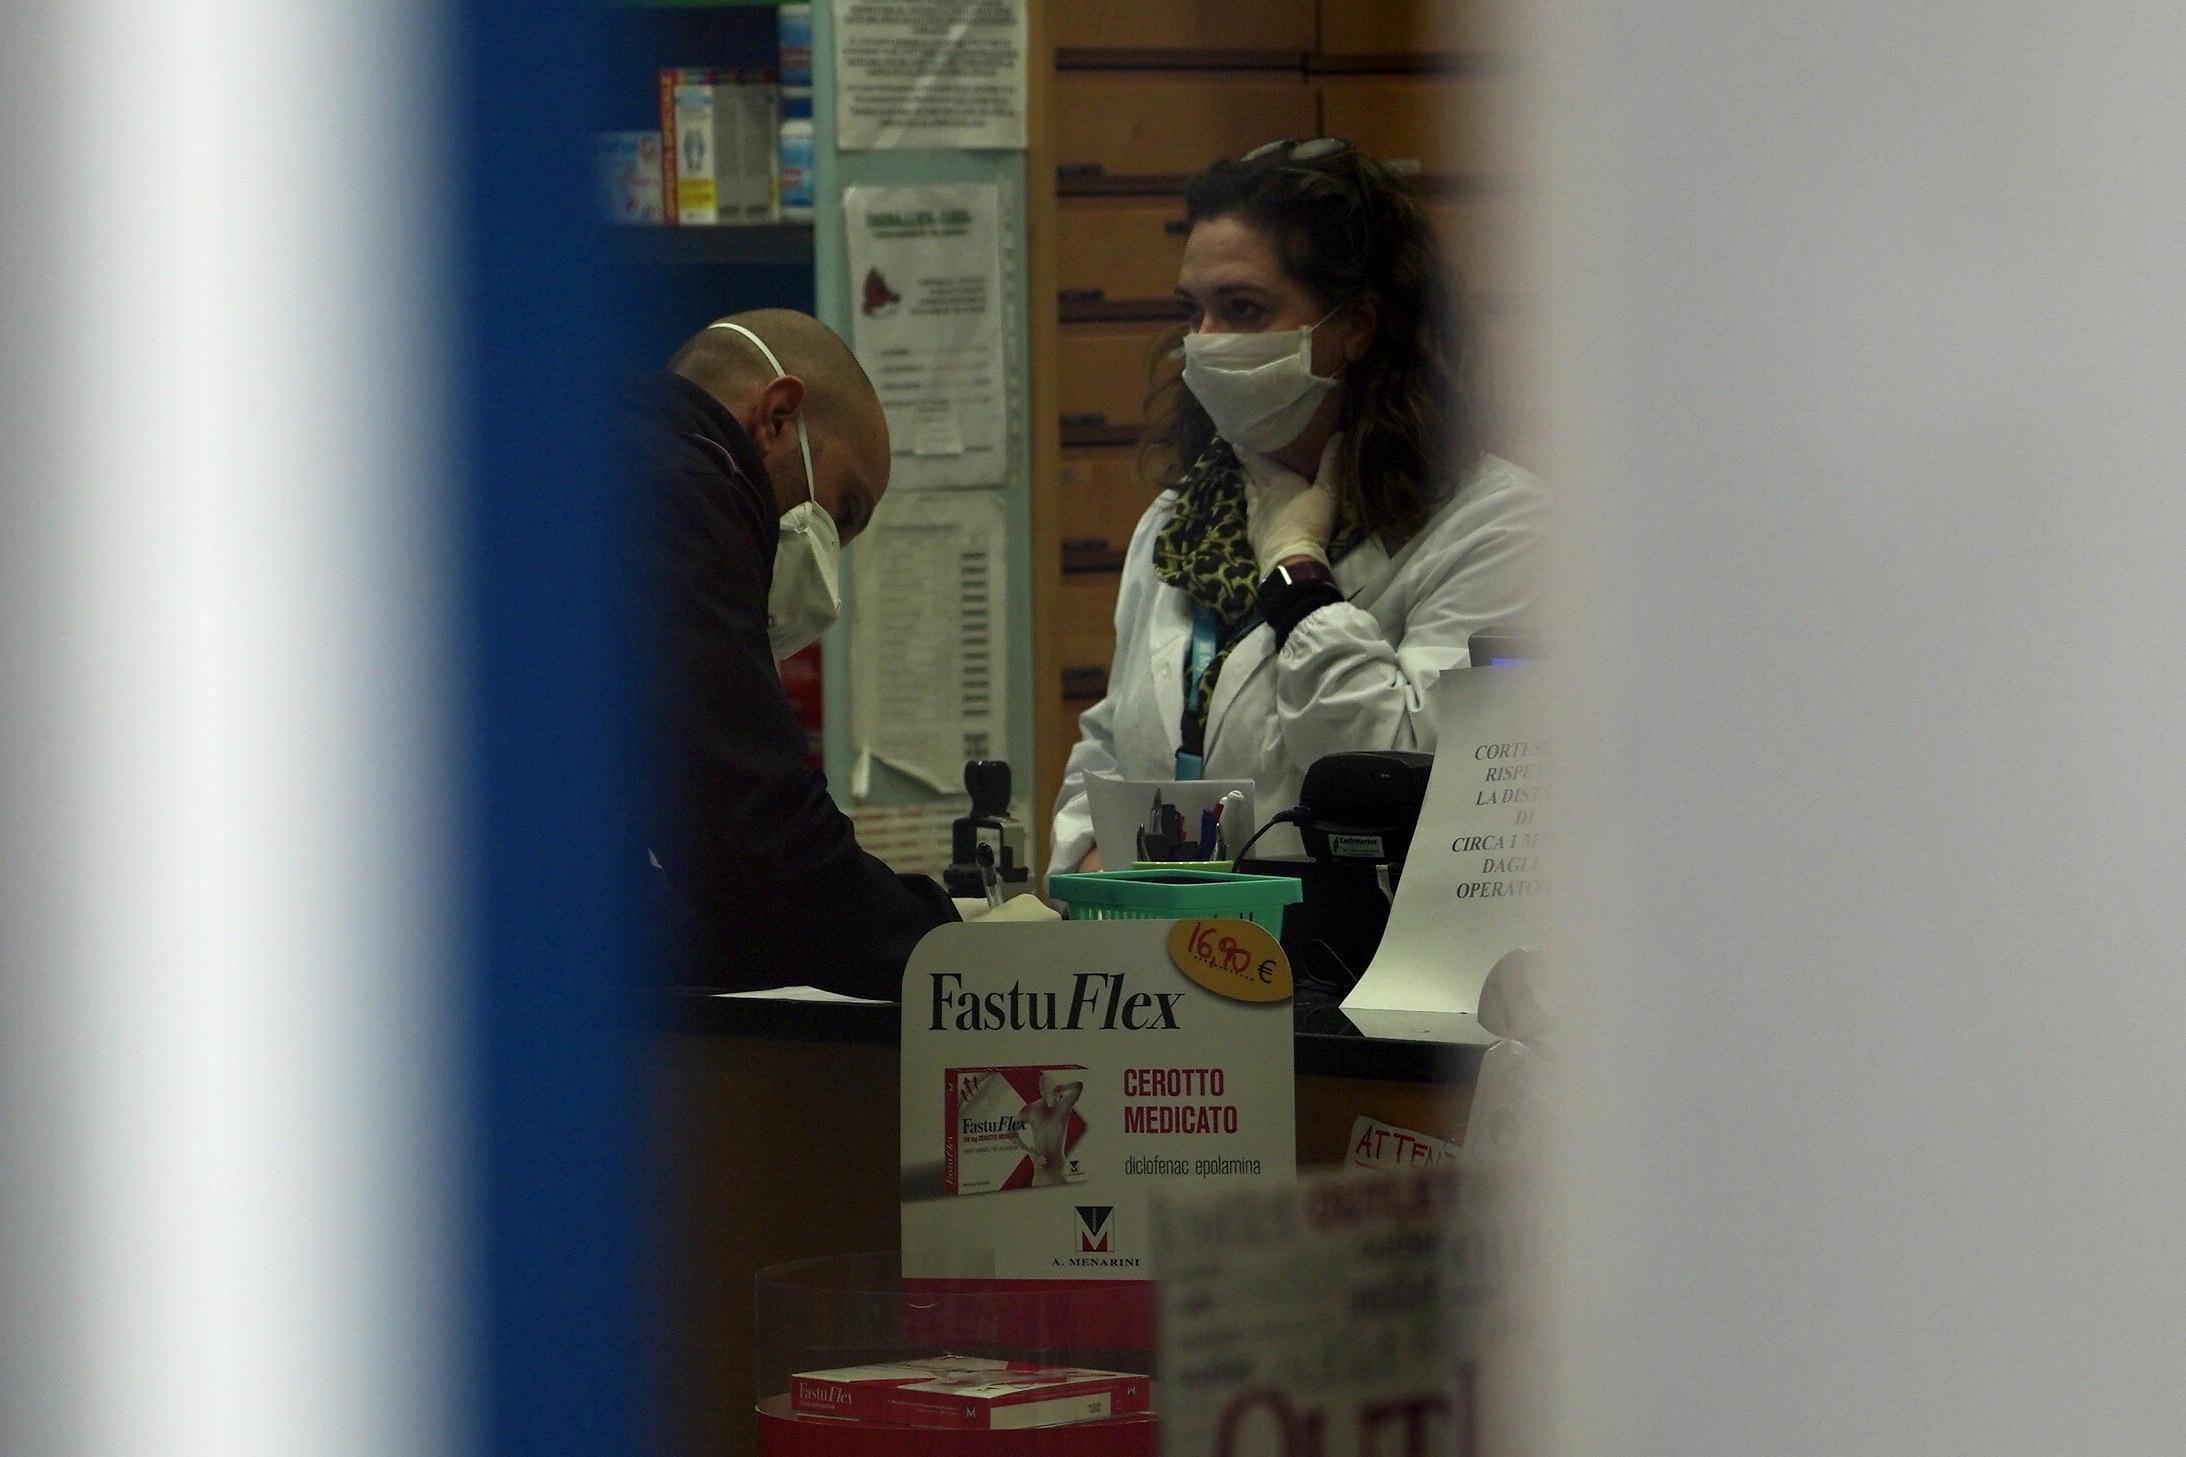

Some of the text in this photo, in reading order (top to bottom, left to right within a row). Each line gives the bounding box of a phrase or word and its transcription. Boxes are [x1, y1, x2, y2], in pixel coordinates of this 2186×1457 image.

[1475, 791, 1498, 806] LA
[1451, 835, 1504, 853] CIRCA
[1123, 1068, 1225, 1098] CEROTTO
[1124, 1105, 1238, 1135] MEDICATO
[1124, 1155, 1262, 1178] diclofenac epolamina
[1070, 1258, 1140, 1267] MENARINI
